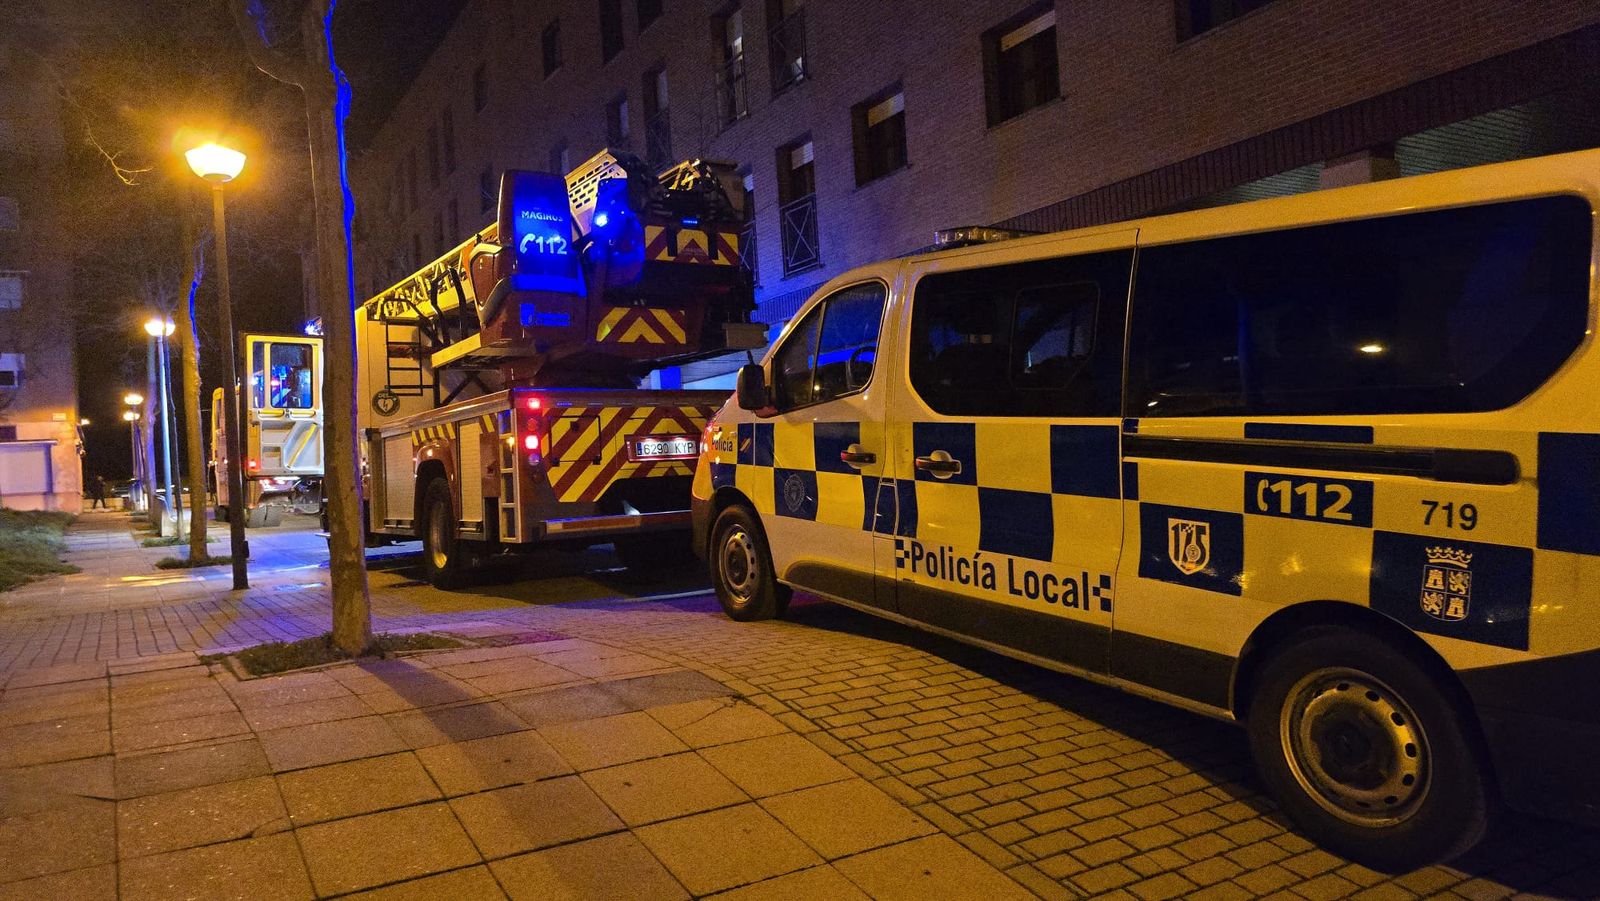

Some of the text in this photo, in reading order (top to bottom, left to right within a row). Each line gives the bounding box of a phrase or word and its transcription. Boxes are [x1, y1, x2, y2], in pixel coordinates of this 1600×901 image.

[535, 235, 567, 254] 112
[643, 442, 669, 455] 6290
[674, 442, 694, 454] KYP
[1270, 480, 1353, 521] 112
[1421, 500, 1478, 531] 719
[911, 540, 1090, 611] Policía Local
